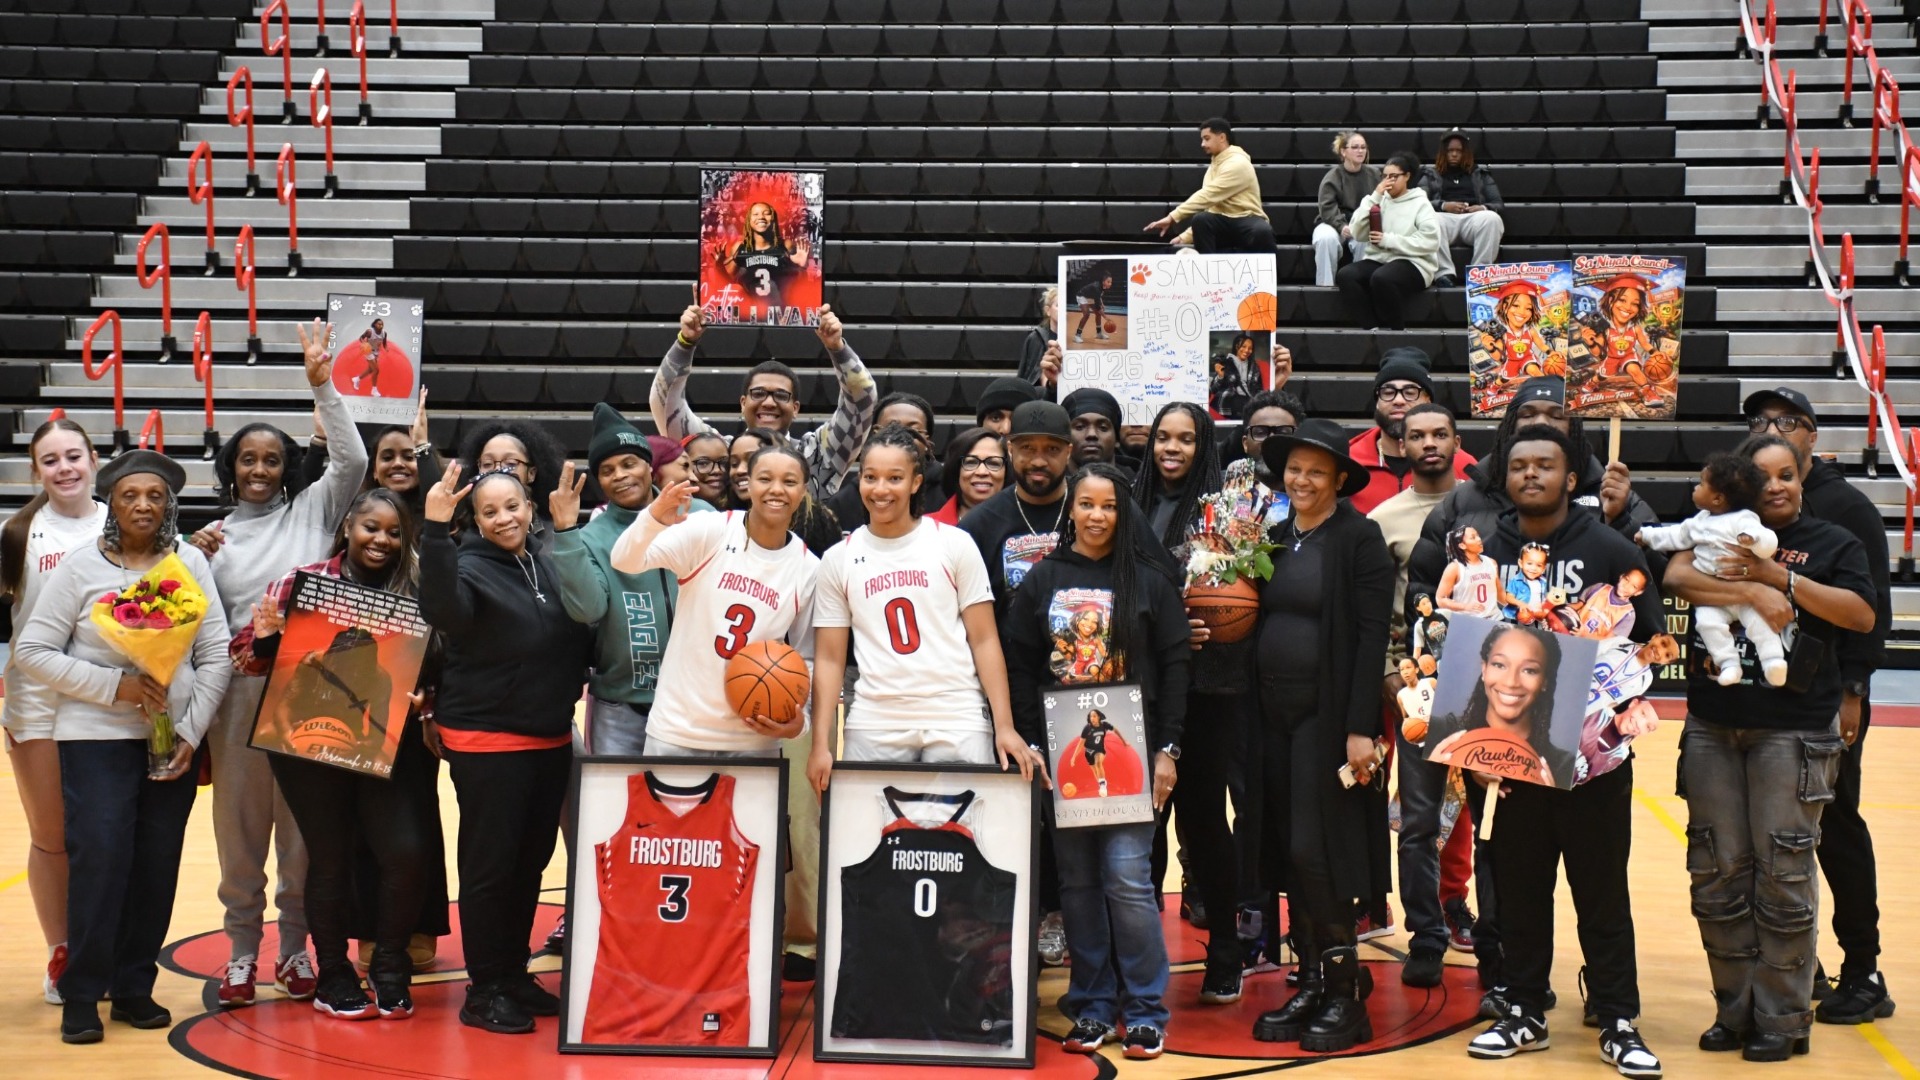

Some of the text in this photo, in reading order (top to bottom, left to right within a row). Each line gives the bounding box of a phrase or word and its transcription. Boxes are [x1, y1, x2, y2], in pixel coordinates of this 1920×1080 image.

[804, 173, 820, 198] 3
[746, 256, 779, 267] FROSTBURG
[1469, 262, 1555, 281] Sa'Niyah Council
[1576, 254, 1669, 271] Sa'Niyah Council
[755, 268, 771, 297] 3
[361, 301, 391, 316] #3
[704, 306, 822, 326] SULLIVAN
[1581, 393, 1604, 404] Faith
[717, 572, 780, 611] FROSTBURG
[864, 570, 928, 599] FROSTBURG
[1476, 583, 1487, 603] 0
[714, 603, 756, 659] 3
[884, 596, 921, 655] 0
[622, 591, 661, 691] EAGLES
[1077, 691, 1109, 709] #0
[1421, 689, 1430, 701] 9
[304, 721, 350, 738] Wilson
[1464, 746, 1537, 776] Rawlings
[629, 836, 722, 868] FROSTBURG
[892, 849, 964, 873] FROSTBURG
[658, 873, 692, 923] 3
[914, 878, 937, 918] 0
